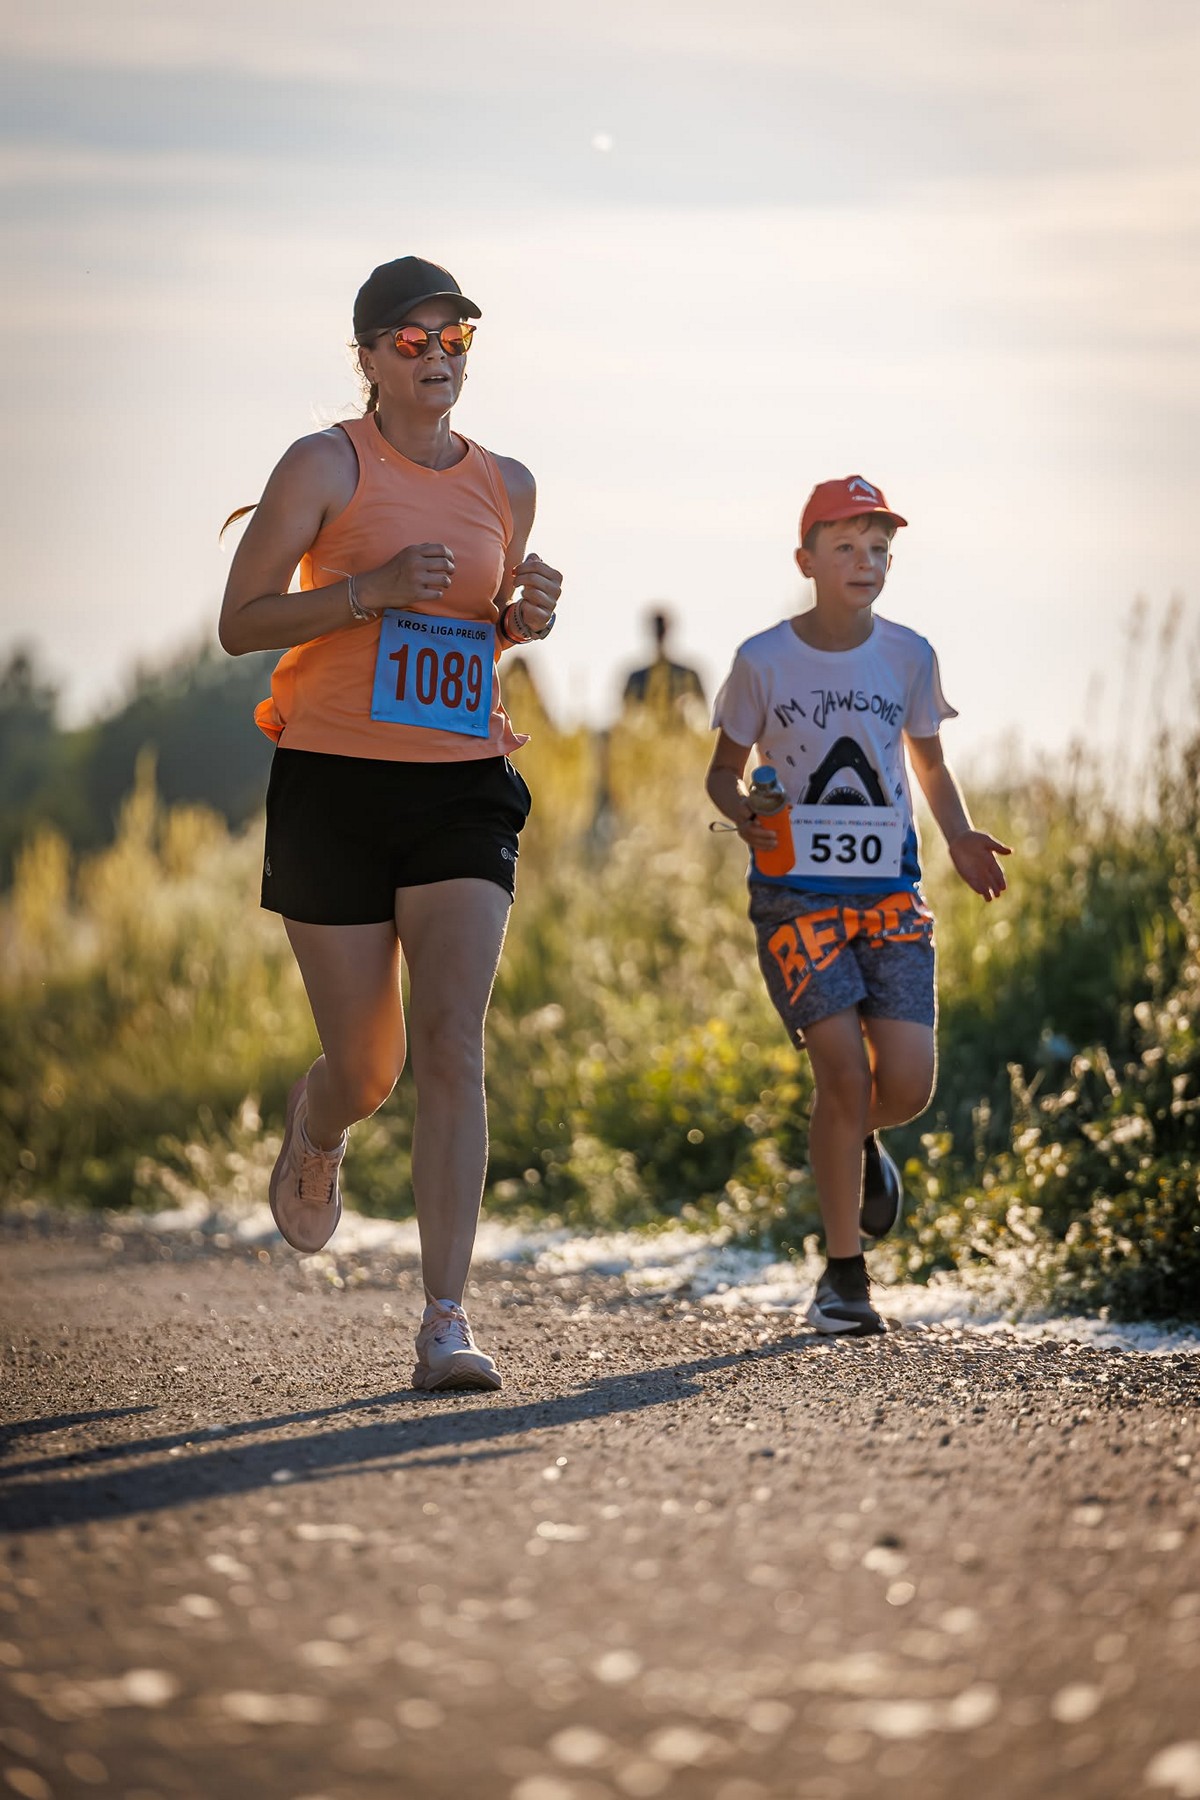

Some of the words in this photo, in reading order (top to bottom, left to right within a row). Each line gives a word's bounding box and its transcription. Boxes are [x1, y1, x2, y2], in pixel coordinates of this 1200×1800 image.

[397, 618, 428, 633] KROS
[430, 625, 454, 637] LIGA
[455, 627, 487, 641] PRELOG
[389, 643, 483, 712] 1089
[811, 689, 903, 729] JAWSOME
[809, 833, 882, 865] 530
